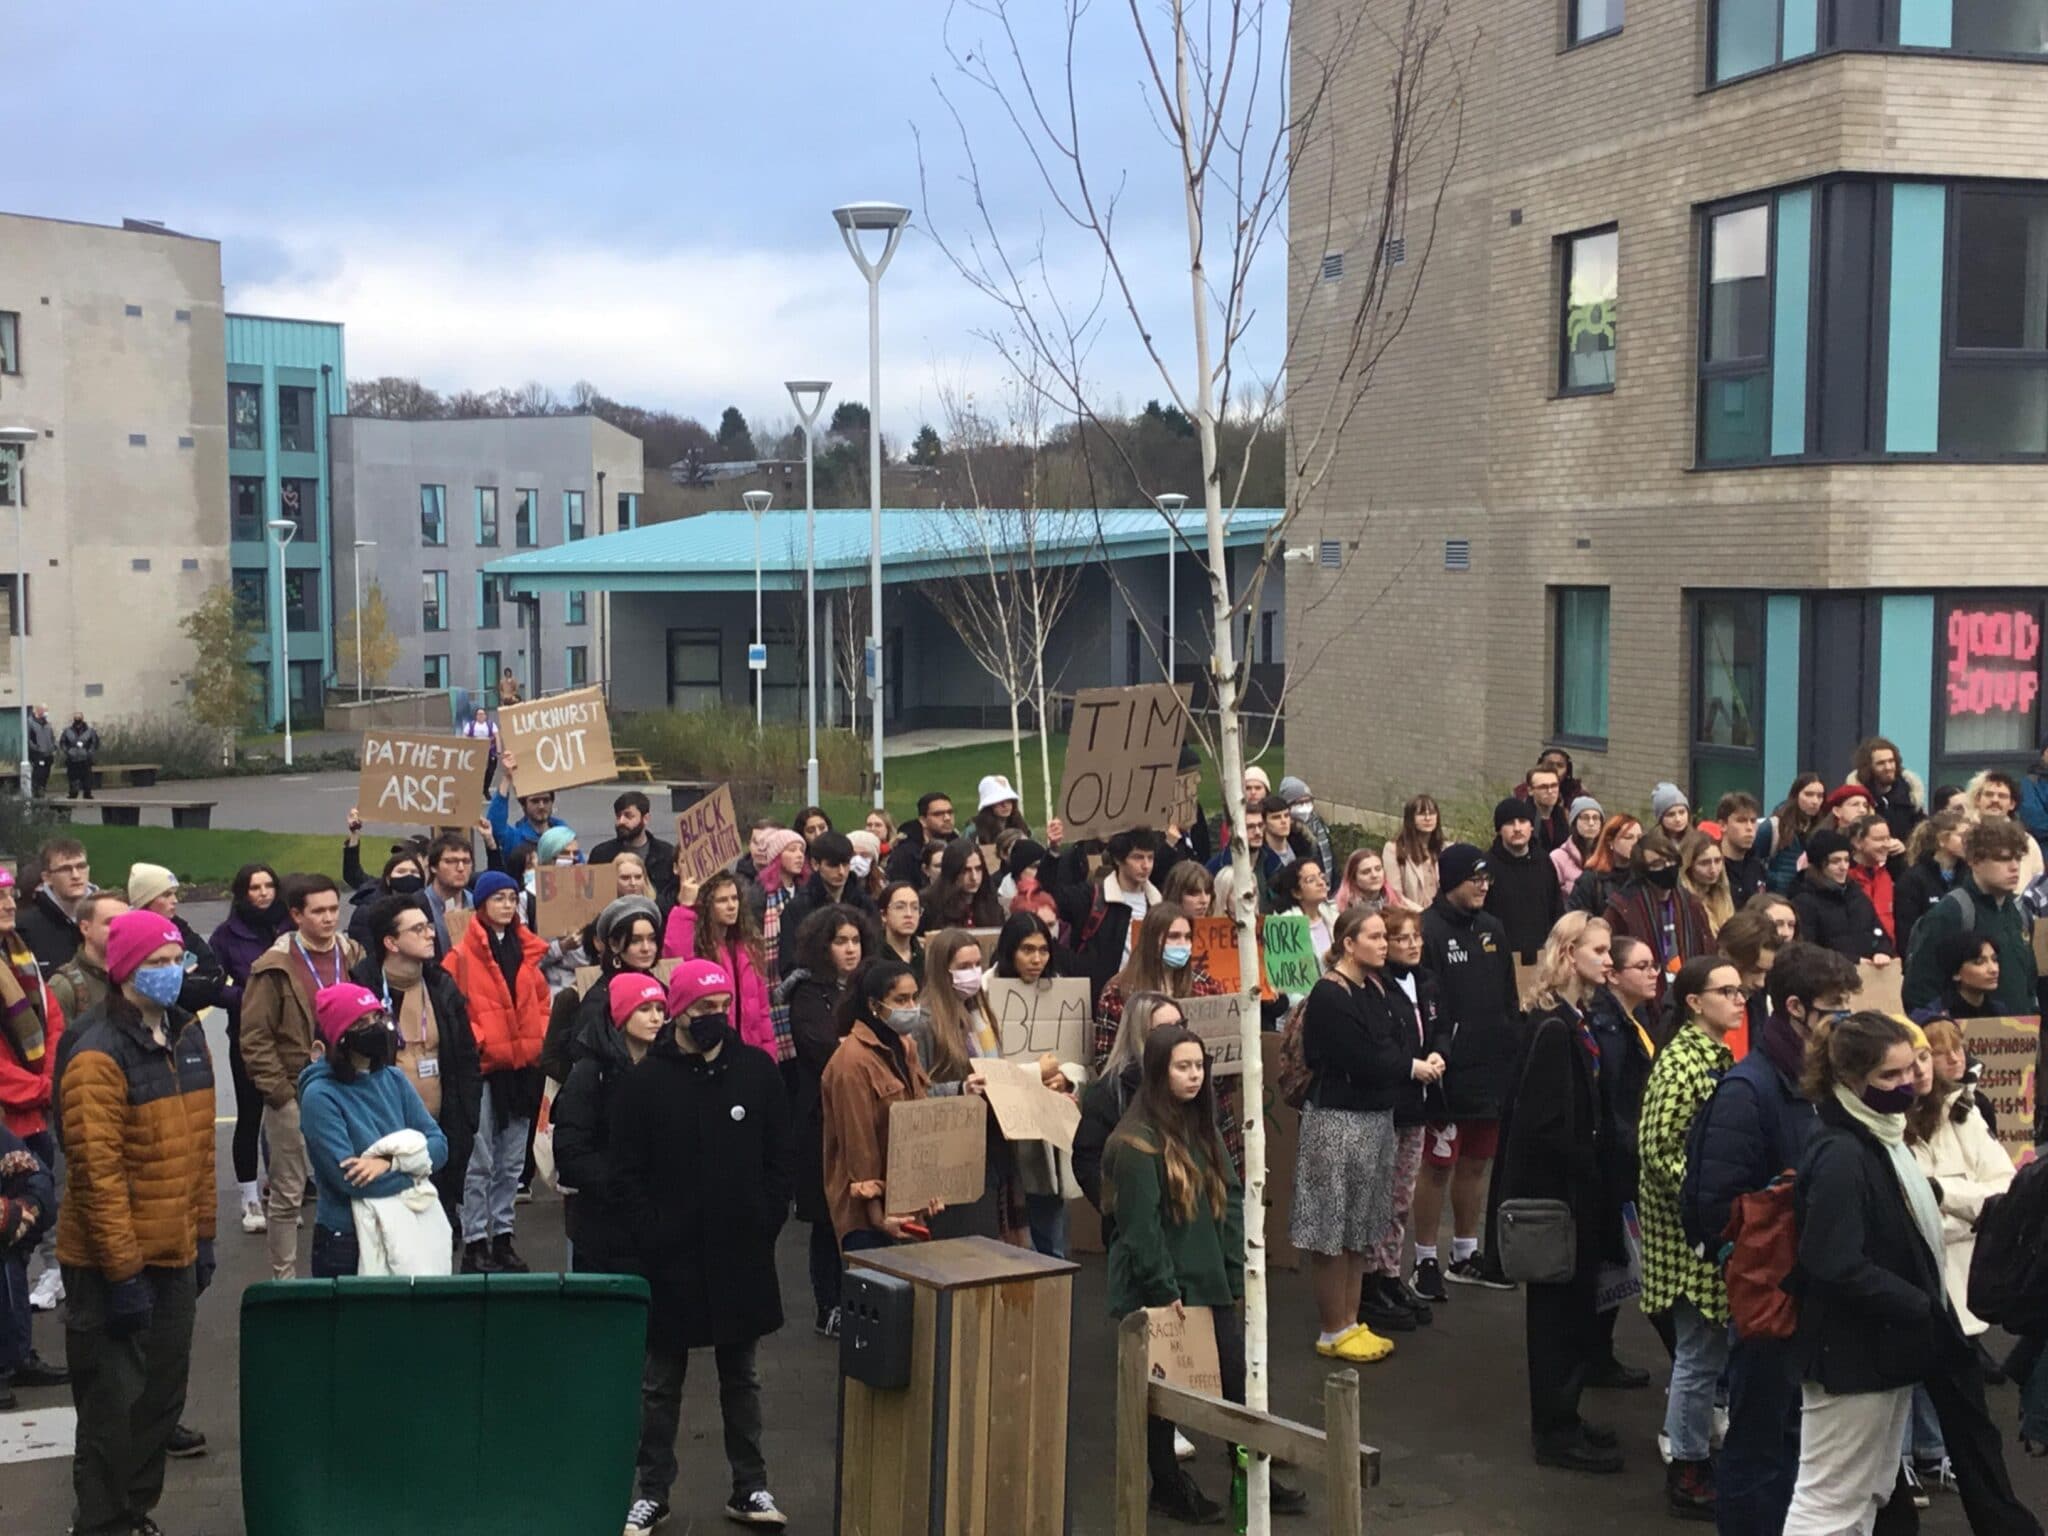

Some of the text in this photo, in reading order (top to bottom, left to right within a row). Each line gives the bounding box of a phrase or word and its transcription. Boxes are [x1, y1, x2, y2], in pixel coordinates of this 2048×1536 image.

[512, 700, 601, 735] LUCKHURST
[1080, 696, 1183, 751] TIM
[365, 739, 475, 772] PATHETIC
[536, 729, 586, 772] OUT
[1066, 763, 1172, 826] OUT.
[680, 796, 726, 849] BLACK
[1267, 960, 1312, 988] WORK
[1447, 950, 1468, 964] NW
[1001, 988, 1087, 1056] BLM
[1963, 1037, 2037, 1056] RANSPHOBIA
